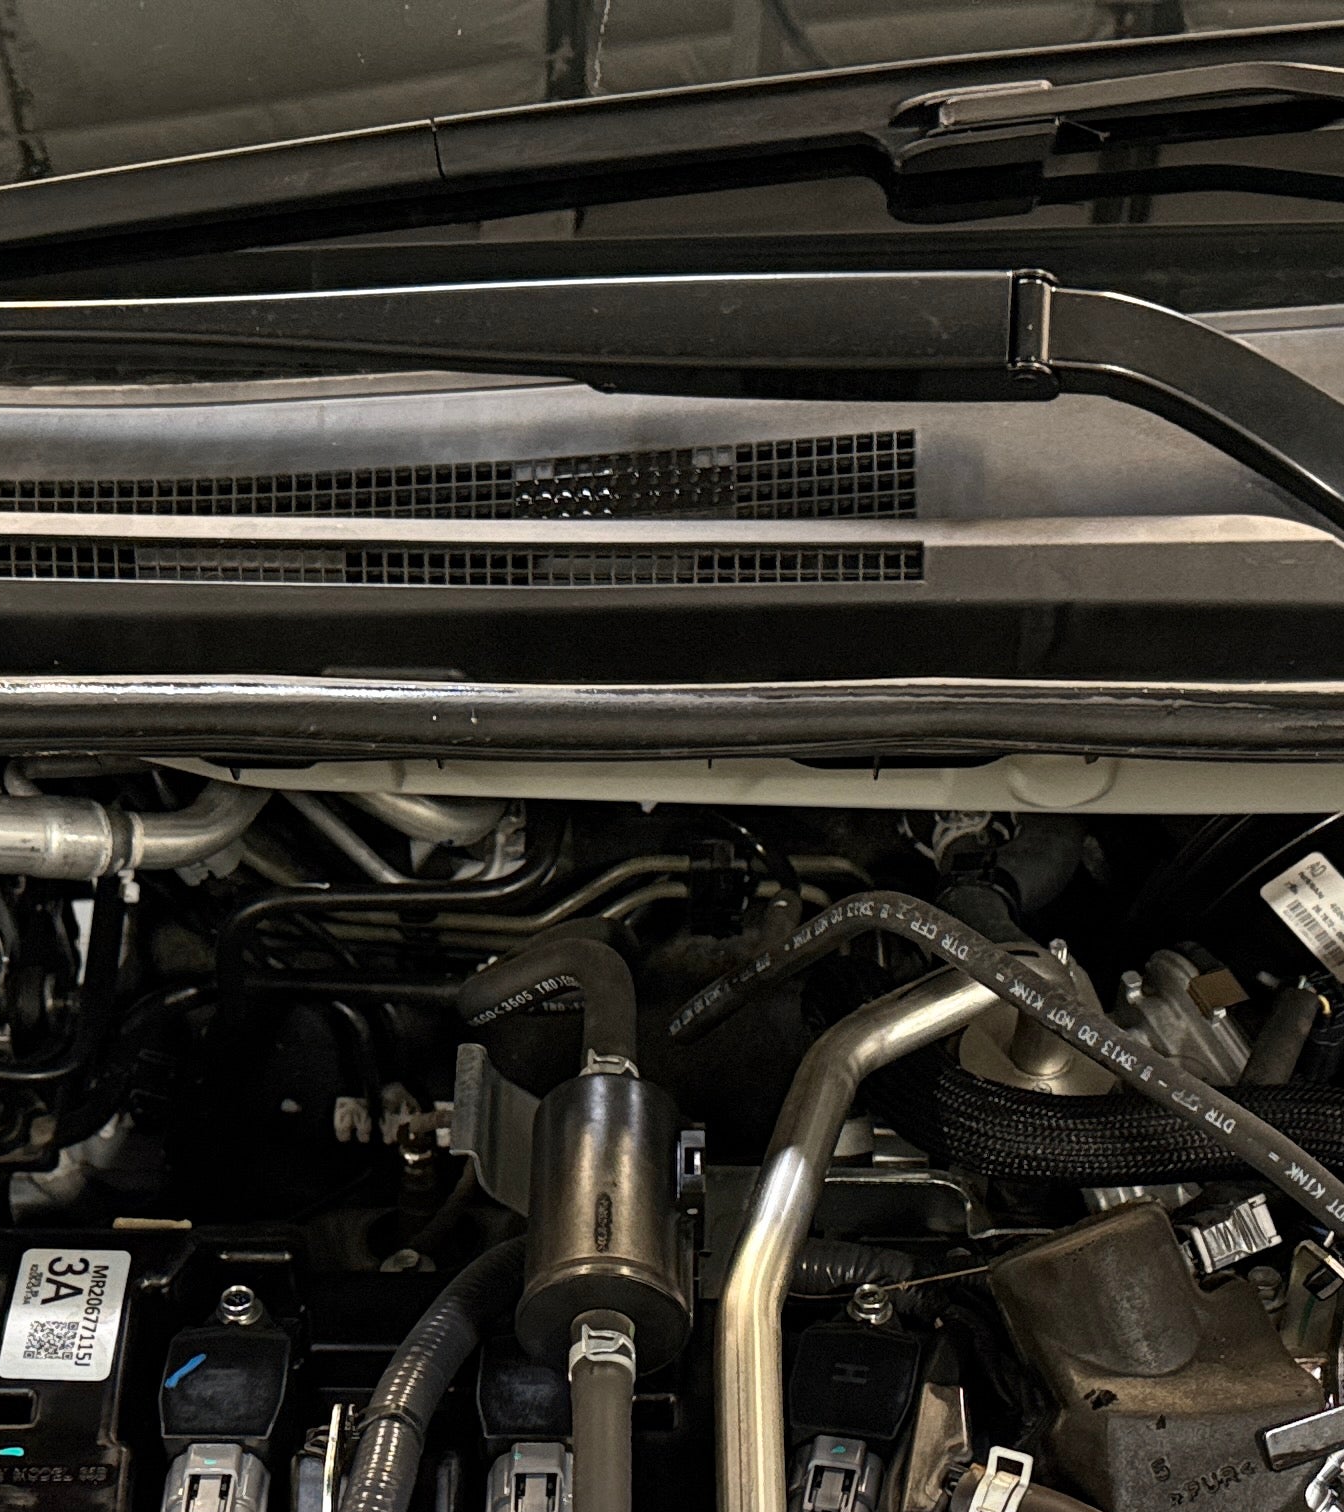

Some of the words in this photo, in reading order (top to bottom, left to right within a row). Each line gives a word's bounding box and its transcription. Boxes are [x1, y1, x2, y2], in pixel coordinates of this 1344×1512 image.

[1009, 979, 1045, 1011] KINK
[1047, 1009, 1075, 1029] NOT
[1206, 1107, 1236, 1134] DTR
[1285, 1162, 1326, 1199] KINK
[41, 1257, 90, 1305] 3A
[75, 1265, 109, 1367] MR20677115J
